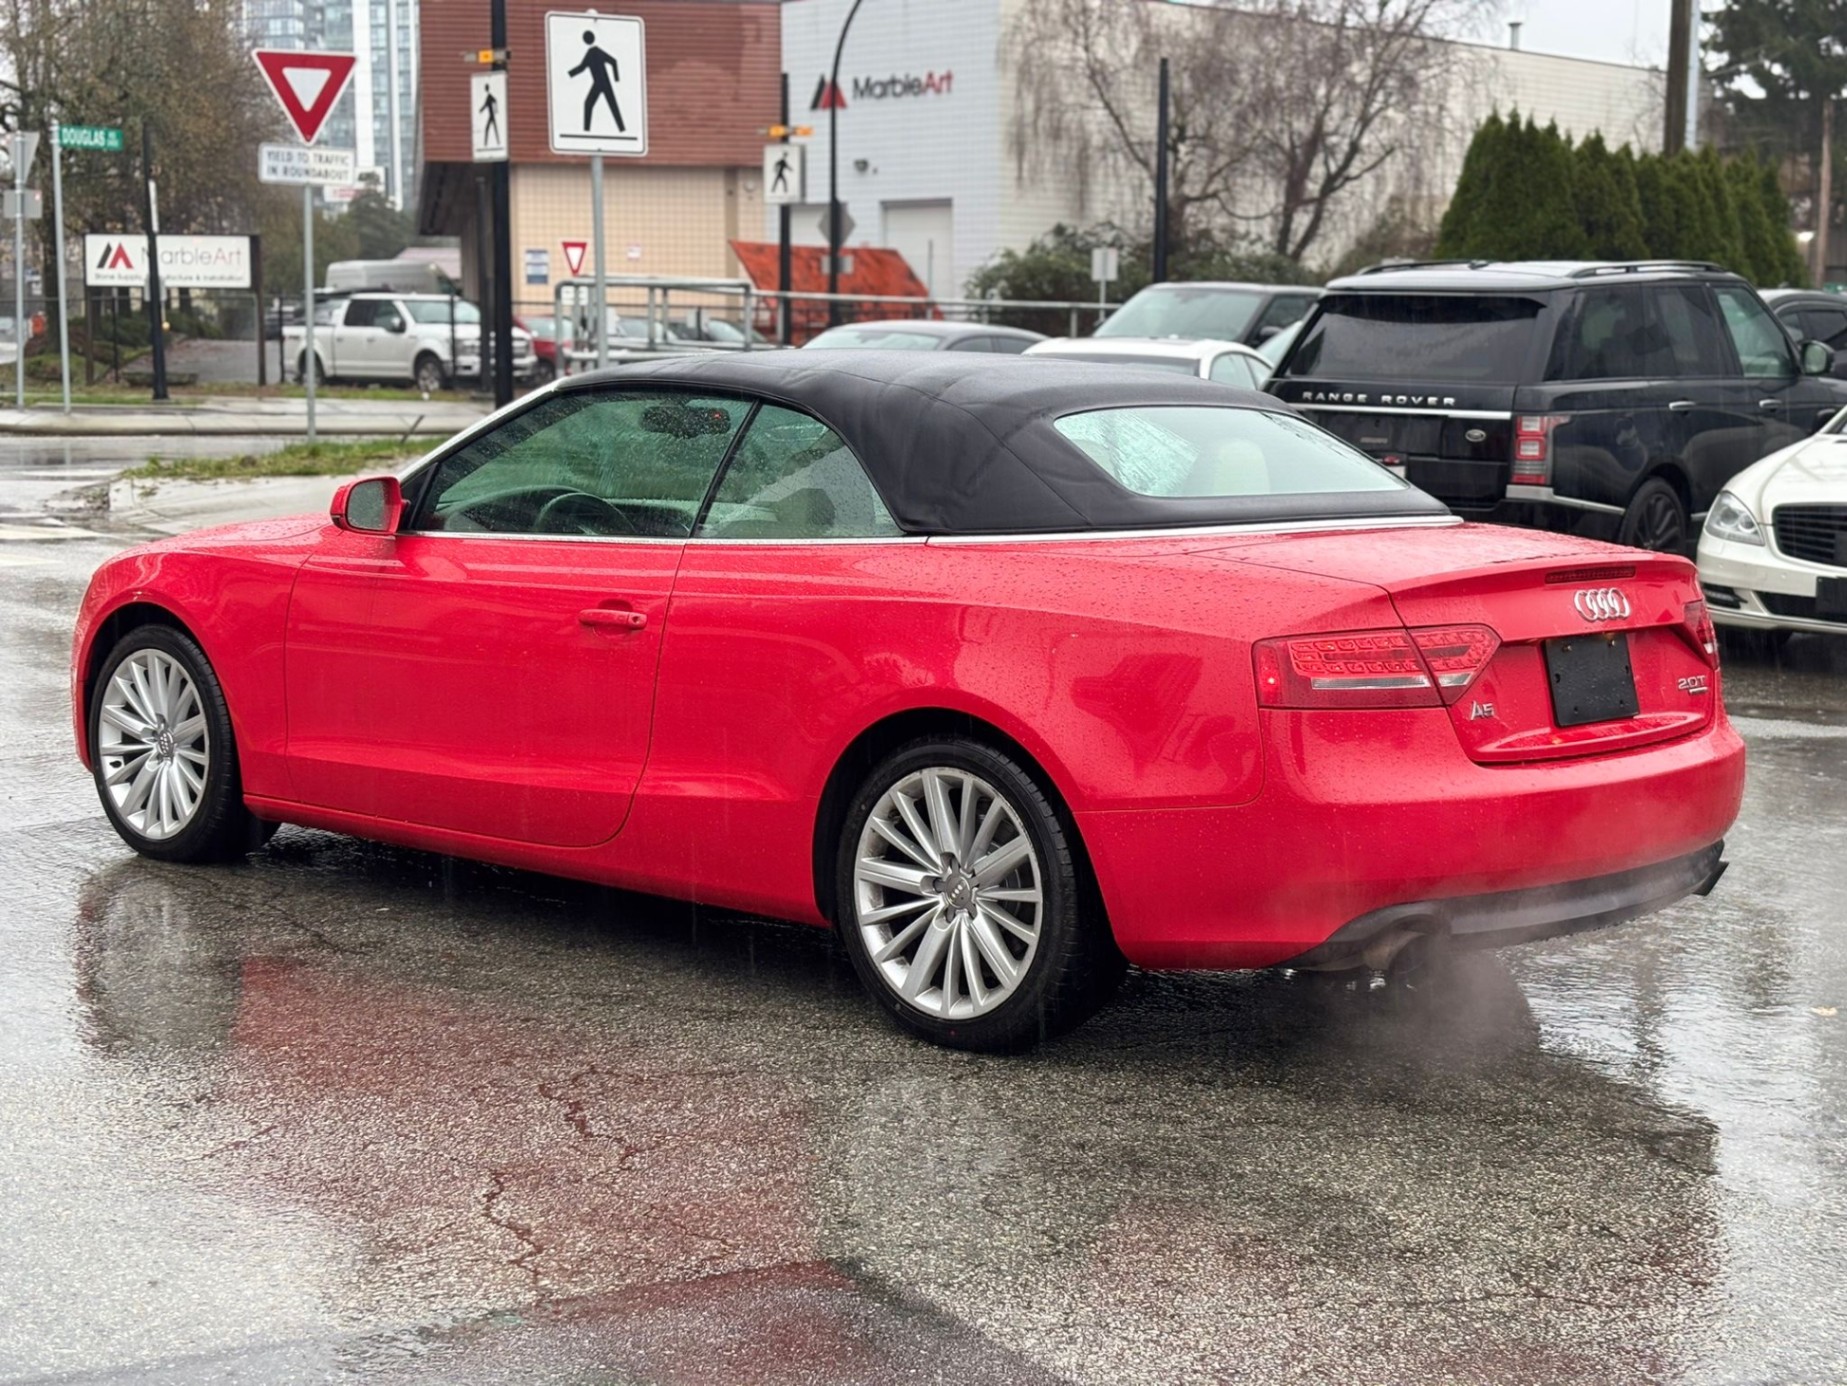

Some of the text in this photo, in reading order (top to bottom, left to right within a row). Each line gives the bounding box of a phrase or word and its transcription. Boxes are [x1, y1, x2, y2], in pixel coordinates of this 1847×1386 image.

[852, 69, 953, 99] MarbleArt
[62, 127, 105, 147] DOUGLAS
[266, 150, 349, 166] YIELD TO TRAFFIC
[266, 164, 278, 176] IN
[283, 165, 349, 180] ROUNDABOUT
[1302, 391, 1456, 407] RANGE ROVER
[1470, 700, 1495, 720] A5
